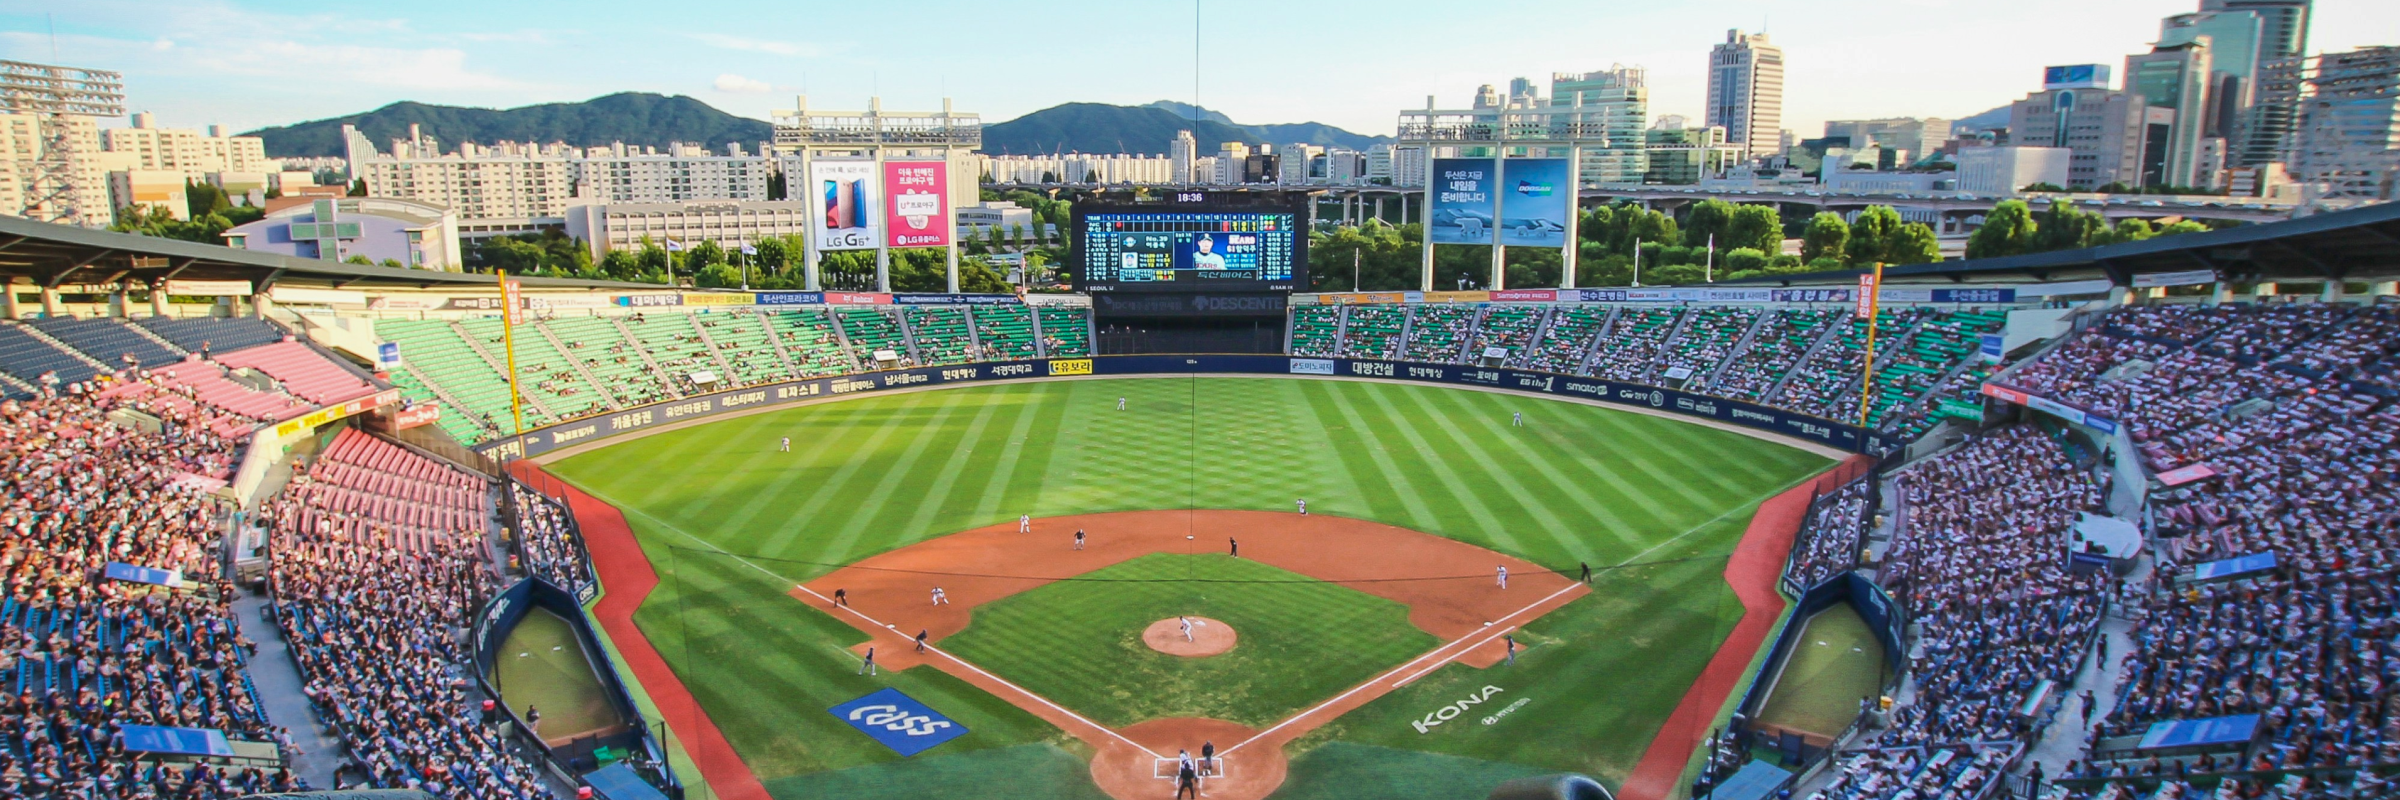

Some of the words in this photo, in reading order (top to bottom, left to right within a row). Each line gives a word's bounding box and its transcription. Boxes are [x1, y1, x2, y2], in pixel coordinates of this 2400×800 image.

[1445, 171, 1467, 180] 두산은
[1468, 171, 1482, 180] 지금
[1450, 181, 1477, 191] 내일을
[1178, 193, 1202, 202] 18:36
[1441, 192, 1485, 202] 준비합니다
[826, 237, 841, 247] LG
[763, 294, 818, 303] 두산인프라코어
[1210, 297, 1284, 310] DESCENTE
[992, 364, 1033, 376] 서경대학교
[1061, 361, 1090, 372] 유보라
[1298, 362, 1332, 372] 도미노피자
[1352, 362, 1394, 376] 대방건설
[942, 368, 976, 380] 현대해상
[1409, 367, 1443, 378] 현대해상
[885, 373, 928, 385] 남서울대학교
[1566, 382, 1597, 393] smato
[722, 391, 766, 407] 미스터피자
[665, 401, 711, 418] 유안타증권
[612, 411, 653, 429] 키움증권
[1412, 685, 1504, 734] KONA
[849, 705, 951, 736] Cass
